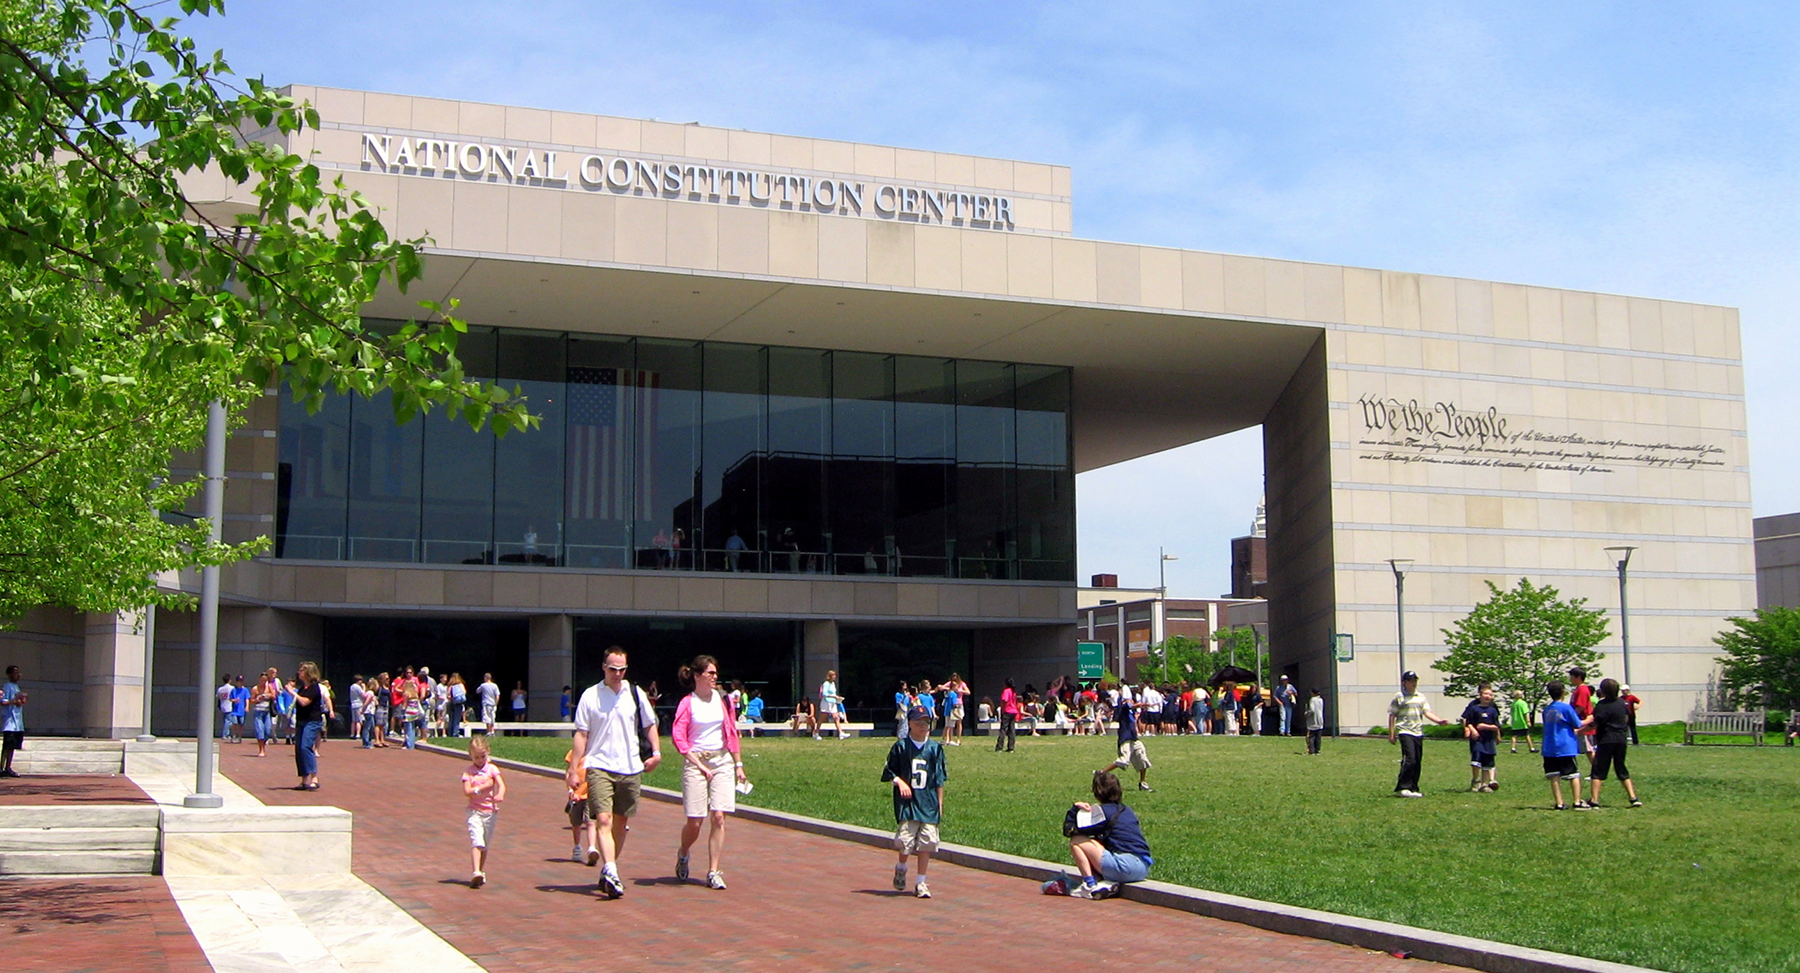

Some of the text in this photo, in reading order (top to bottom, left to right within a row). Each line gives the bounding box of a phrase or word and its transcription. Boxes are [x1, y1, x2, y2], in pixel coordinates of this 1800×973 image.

[362, 133, 1015, 229] NATIONAL CONSTITUTION CENTER
[1357, 393, 1402, 435] We
[1401, 399, 1439, 438] the
[1432, 401, 1512, 449] People
[911, 758, 927, 789] 5
